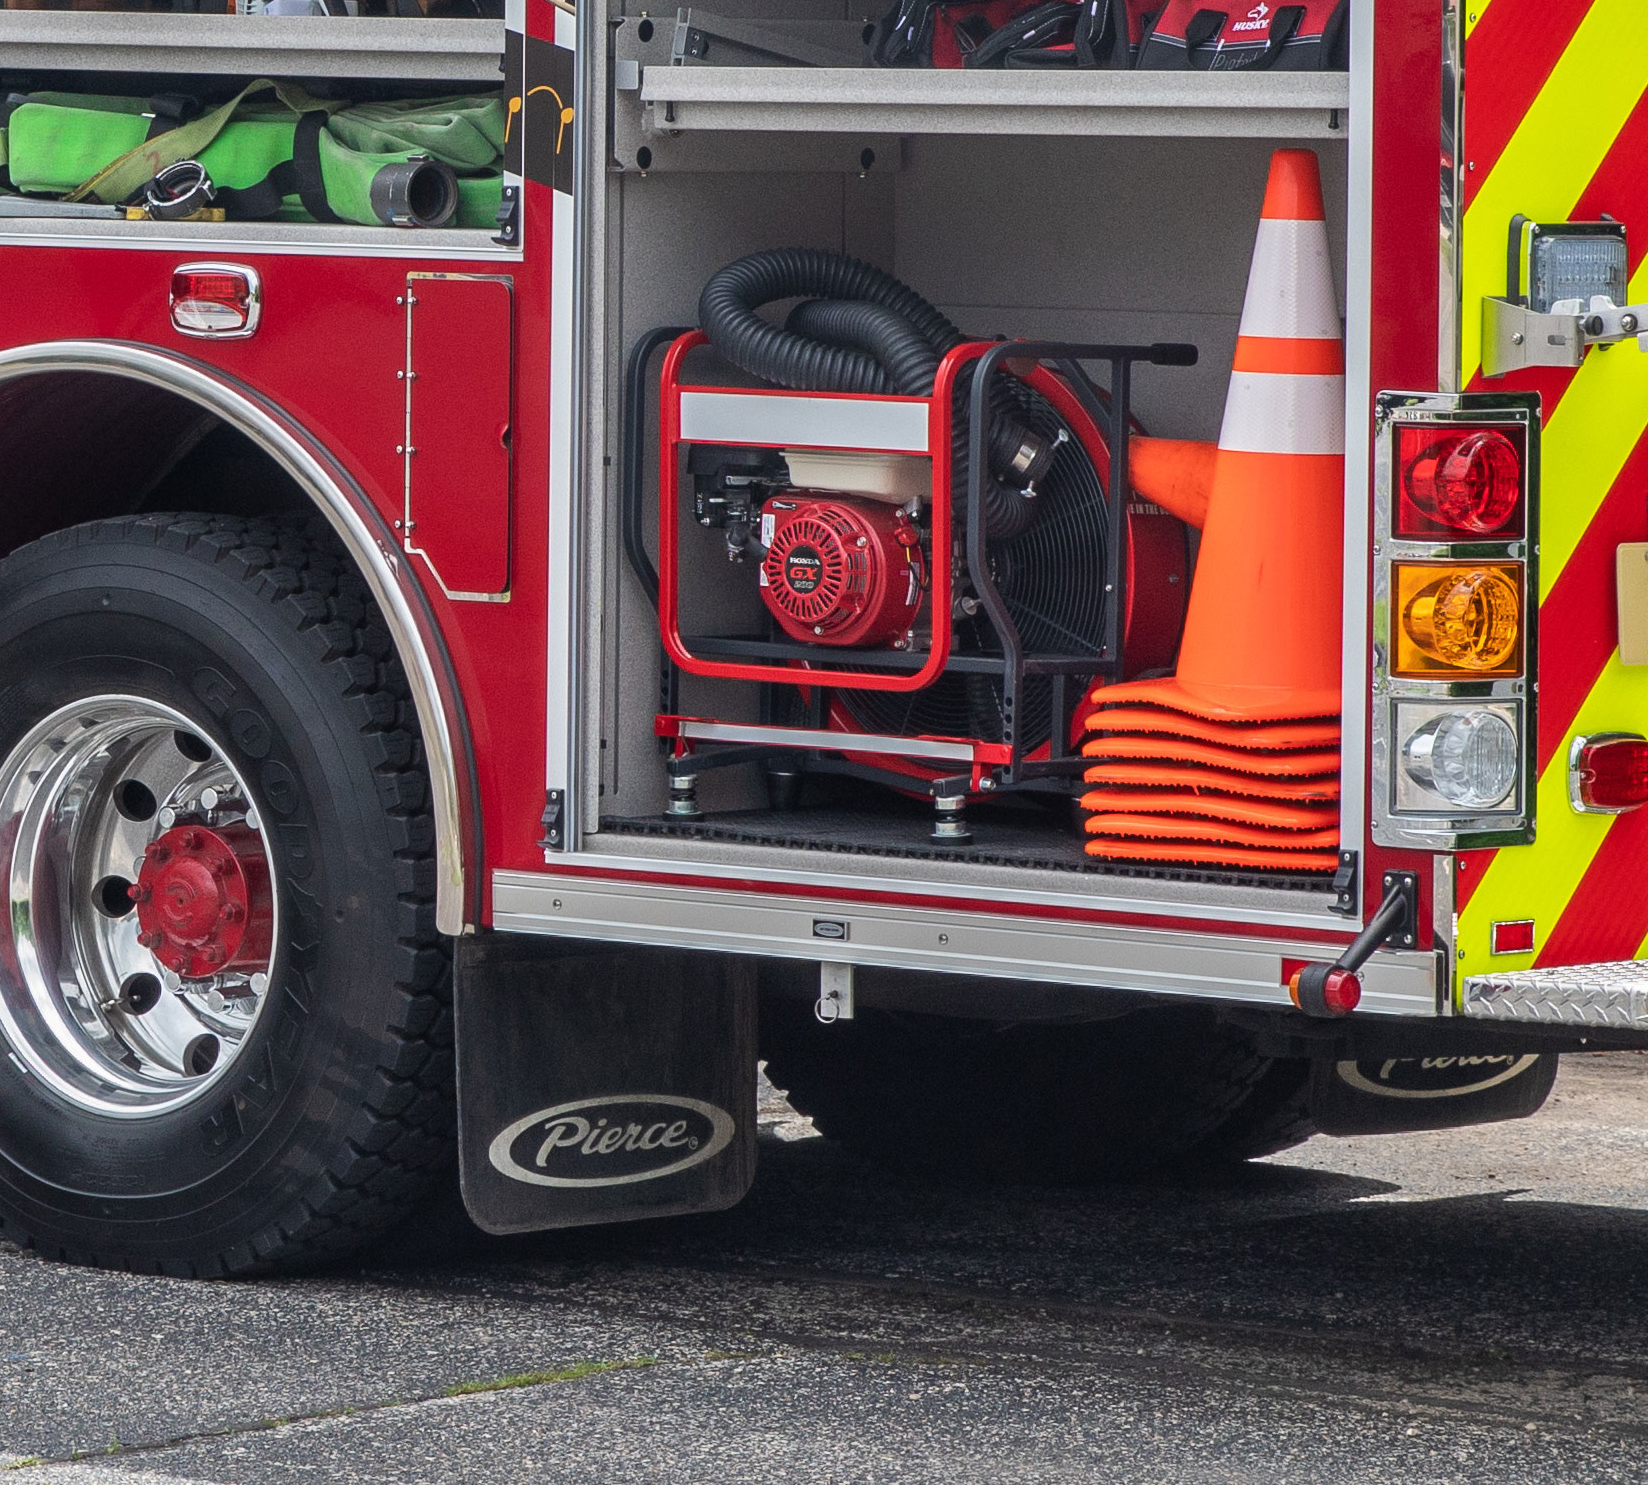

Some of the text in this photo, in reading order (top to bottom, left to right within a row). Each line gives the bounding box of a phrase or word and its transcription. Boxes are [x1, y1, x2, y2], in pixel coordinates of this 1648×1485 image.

[1232, 19, 1270, 32] HUSKY
[790, 556, 821, 565] HONDA
[790, 567, 819, 580] GX
[193, 664, 318, 1154] GOODYEAR
[535, 1116, 690, 1167] Pierce
